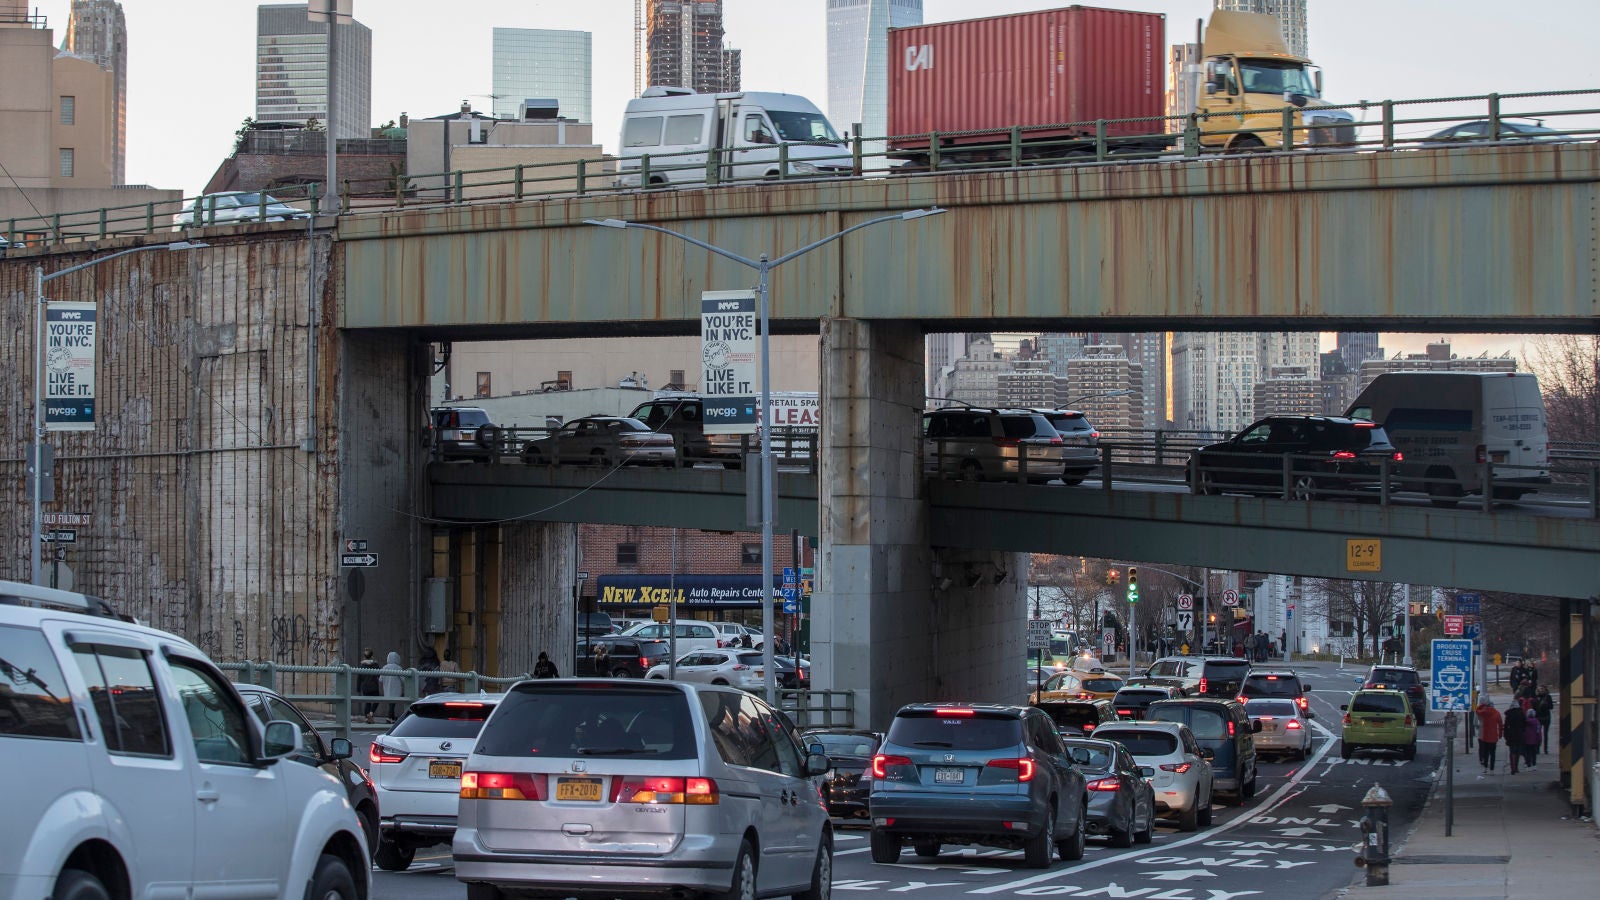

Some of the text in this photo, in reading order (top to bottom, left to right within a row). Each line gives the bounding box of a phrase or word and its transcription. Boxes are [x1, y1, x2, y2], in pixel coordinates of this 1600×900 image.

[905, 43, 934, 71] CAI
[718, 302, 739, 310] NYC
[61, 311, 81, 320] NYC
[705, 315, 753, 328] YOU'RE
[49, 324, 93, 335] YOU'RE
[705, 328, 753, 341] IN NYC.
[49, 335, 92, 347] IN NYC.
[49, 373, 75, 384] LIVE
[706, 369, 734, 382] LIVE
[49, 384, 91, 395] LIKE IT.
[706, 381, 753, 394] LIKE IT.
[48, 407, 77, 416] nycgo
[706, 407, 737, 417] nycgo
[775, 409, 819, 424] LEAS
[44, 514, 91, 524] OLD FULTON ST
[602, 586, 686, 603] NEW XCELL
[689, 588, 709, 597] Auto
[711, 588, 740, 599] Repairs
[742, 588, 764, 597] Cente
[1326, 756, 1411, 767] ONLY
[1202, 840, 1353, 851] ONLY
[1134, 856, 1318, 869] ONLY
[1013, 882, 1264, 900] ONLY
